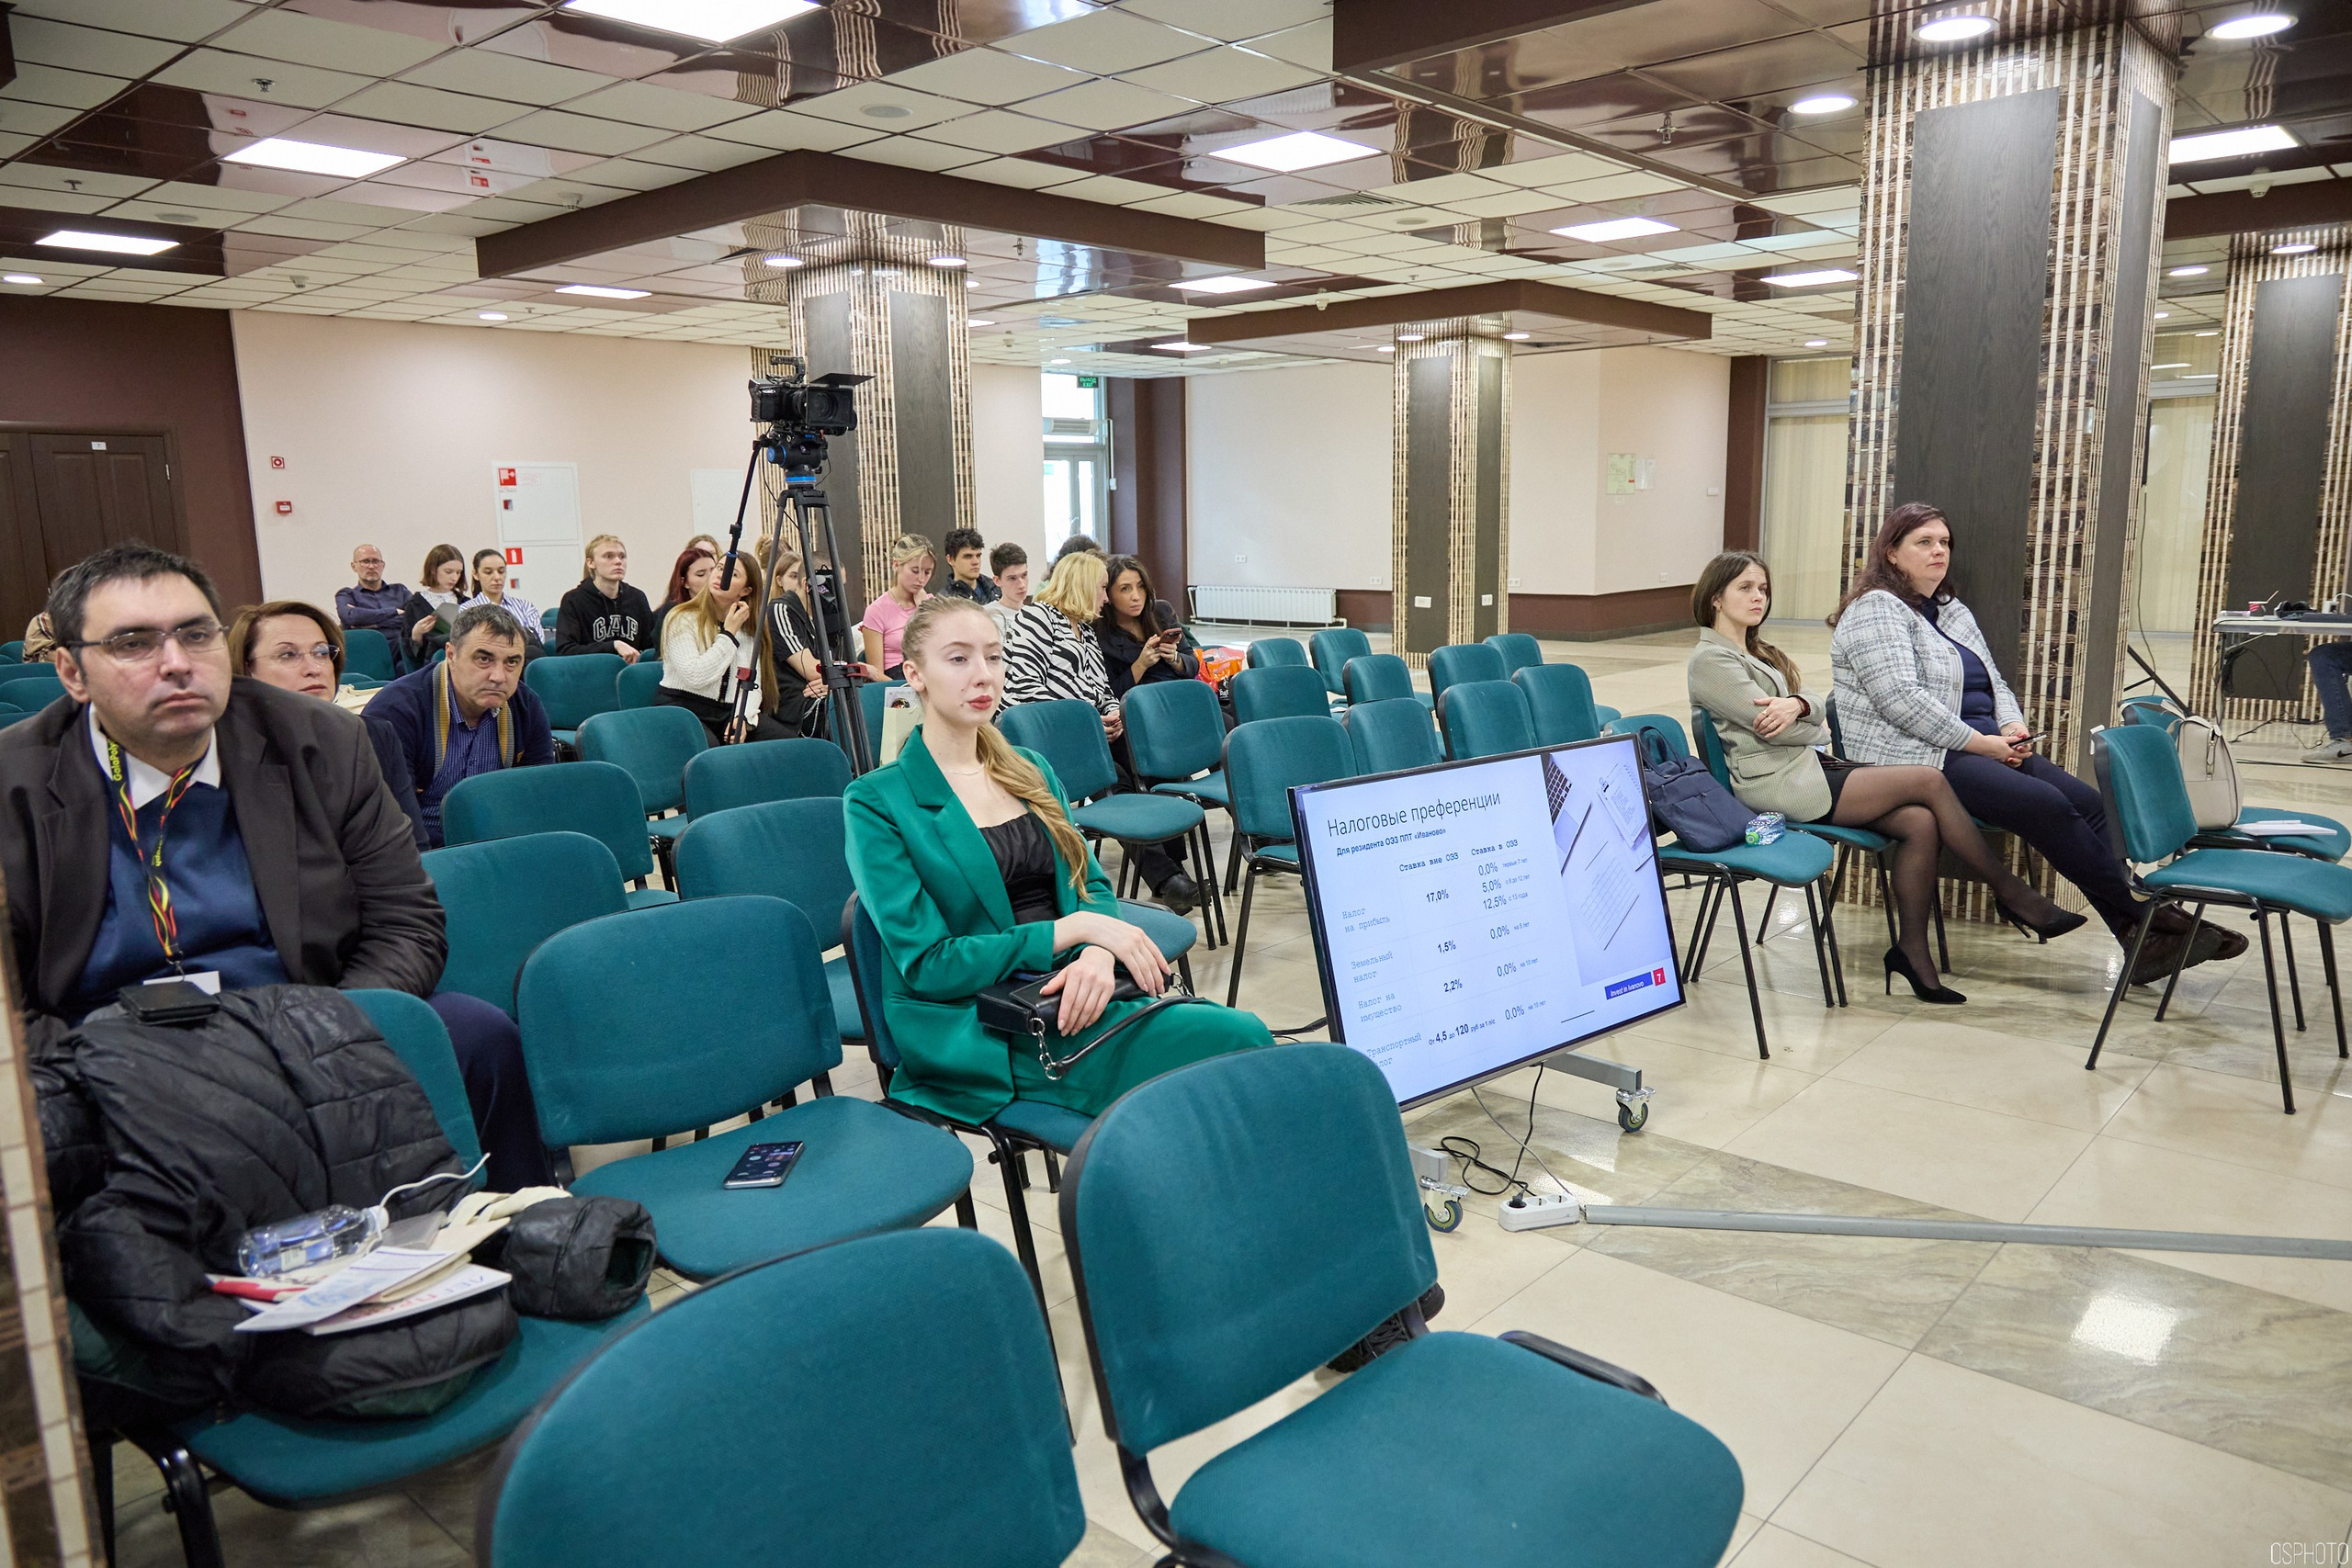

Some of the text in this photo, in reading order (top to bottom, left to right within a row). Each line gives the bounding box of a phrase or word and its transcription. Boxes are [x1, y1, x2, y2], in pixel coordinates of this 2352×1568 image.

[593, 614, 639, 642] GAP
[1328, 793, 1501, 837] Налоговые преференции
[1337, 829, 1446, 856] Для резидента ОЭЗ ППТ «Иваново»
[1471, 845, 1496, 856] Ставка
[1399, 860, 1426, 872] Ставка
[1430, 857, 1442, 865] вне
[1477, 862, 1498, 876] 0,0%
[1482, 878, 1502, 893] 5,0%
[1426, 889, 1449, 903] 17,0%
[1483, 895, 1507, 909] 12,5%
[1342, 908, 1366, 919] Налог
[1344, 916, 1391, 932] на прибыль
[1489, 924, 1510, 940] 0,0%
[1437, 940, 1456, 953] 1,5%
[1351, 950, 1394, 969] Земельный
[1497, 962, 1517, 977] 0,0%
[1353, 971, 1377, 984] налог
[1657, 973, 1661, 983] 7
[1443, 978, 1463, 993] 2,2%
[1611, 987, 1623, 998] Invest
[1628, 981, 1645, 991] Ivanovo
[1358, 993, 1396, 1010] Налог на
[1361, 1004, 1402, 1022] имущество
[1504, 1005, 1524, 1021] 0,0%
[1435, 1031, 1447, 1043] 4,5
[1455, 1023, 1469, 1036] 120
[1366, 1032, 1421, 1058] Транспортный
[1374, 1057, 1393, 1068] лог
